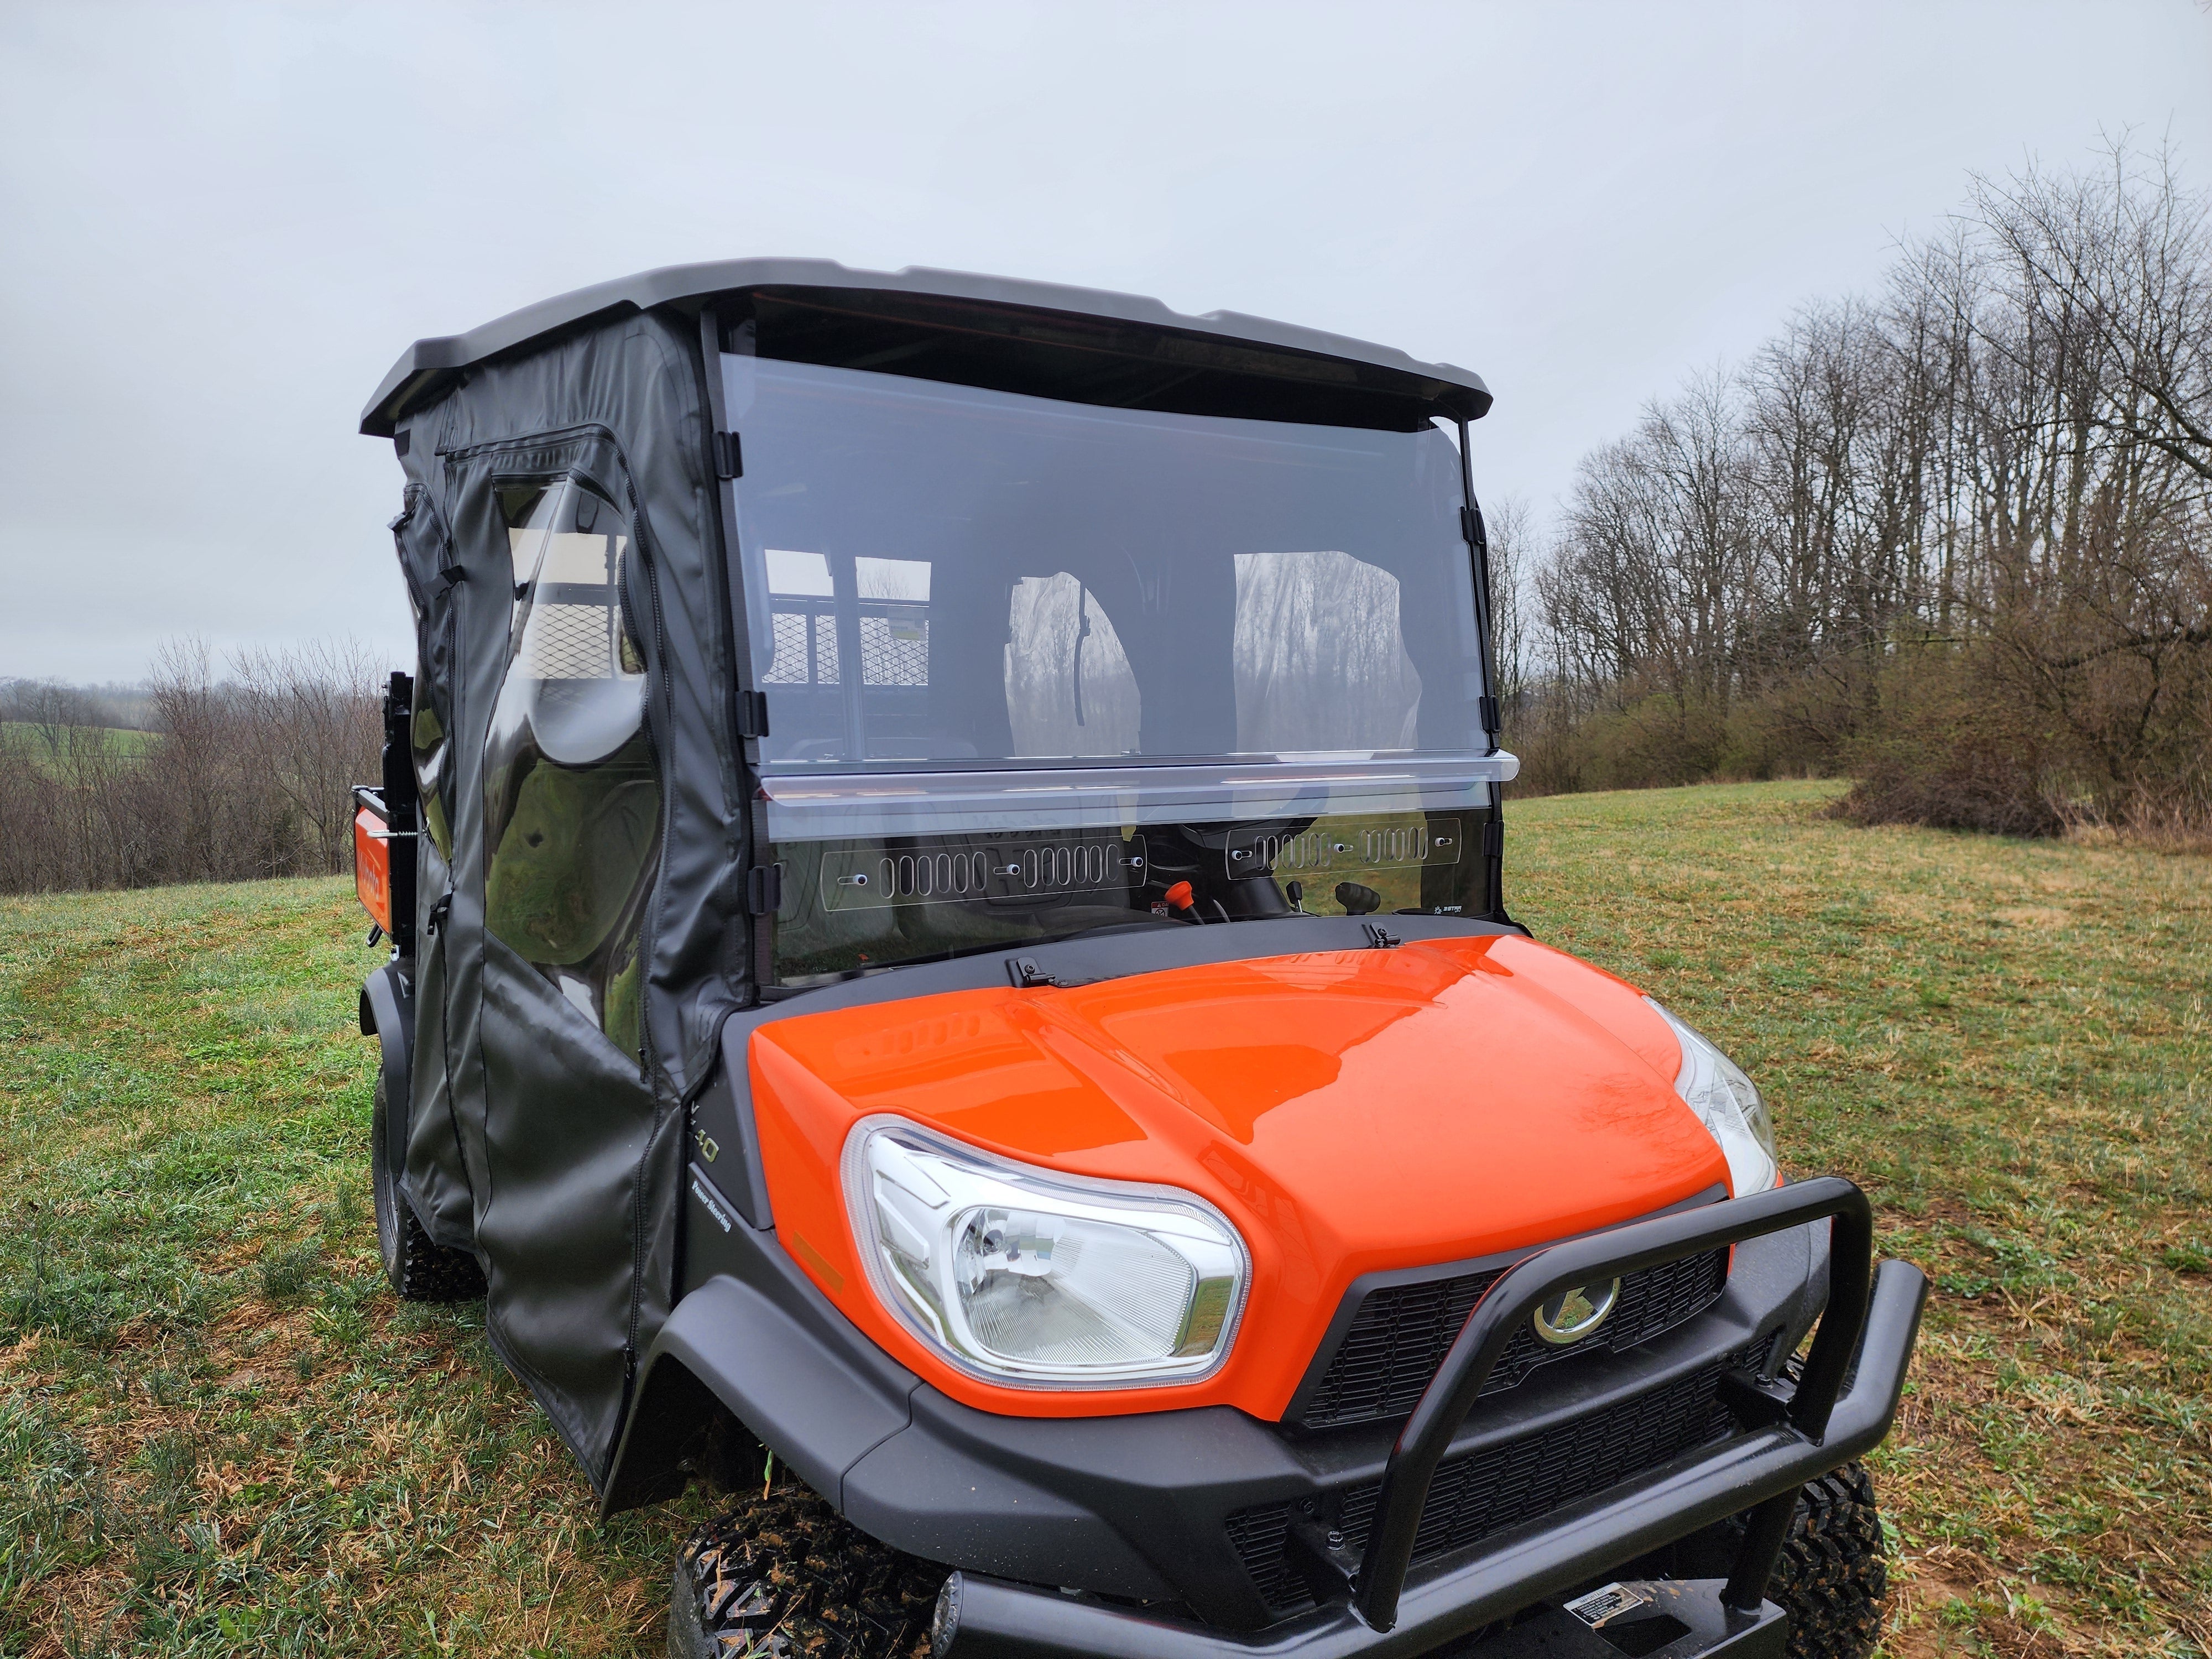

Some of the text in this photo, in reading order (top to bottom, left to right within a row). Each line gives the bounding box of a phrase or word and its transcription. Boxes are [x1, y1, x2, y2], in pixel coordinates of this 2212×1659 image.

[357, 848, 380, 902] Kubota
[692, 1181, 731, 1233] Power Steering
[1579, 1589, 1606, 1604] IMPORTANT
